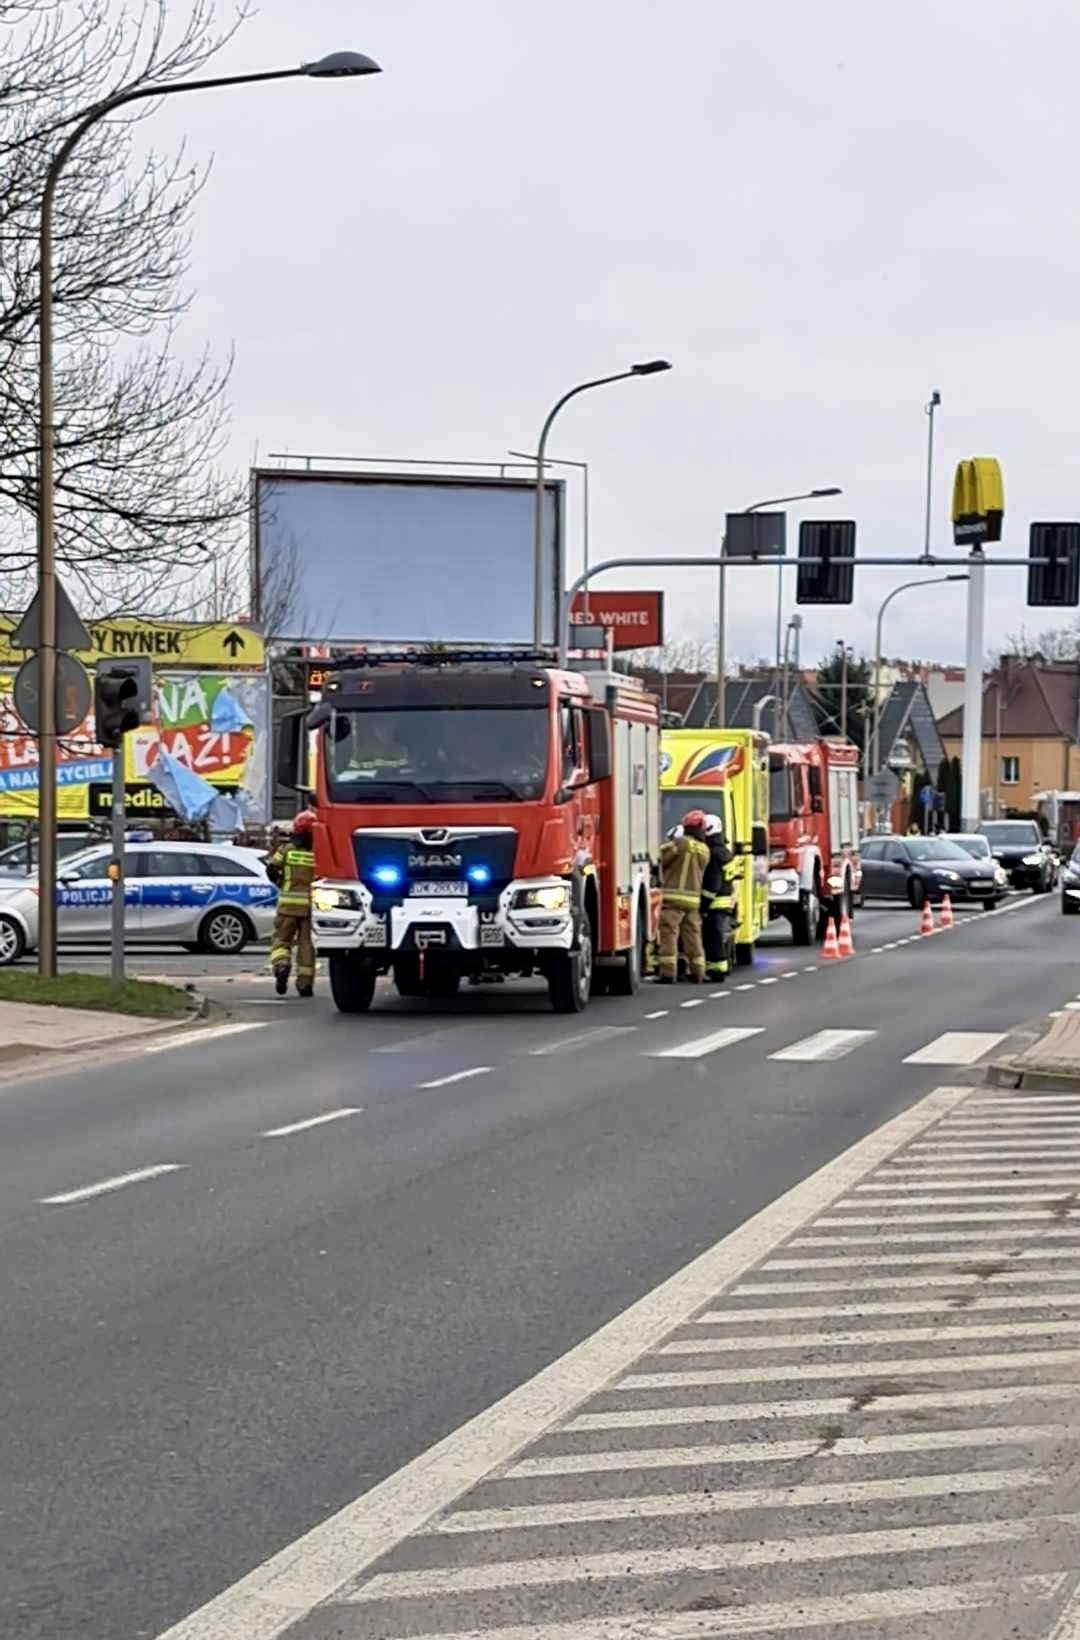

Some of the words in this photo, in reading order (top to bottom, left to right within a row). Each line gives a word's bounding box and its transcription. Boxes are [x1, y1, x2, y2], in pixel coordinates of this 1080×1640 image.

[568, 611, 595, 625] RED
[599, 611, 649, 625] WHITE
[112, 630, 181, 653] RYNEK
[408, 854, 462, 868] MAN
